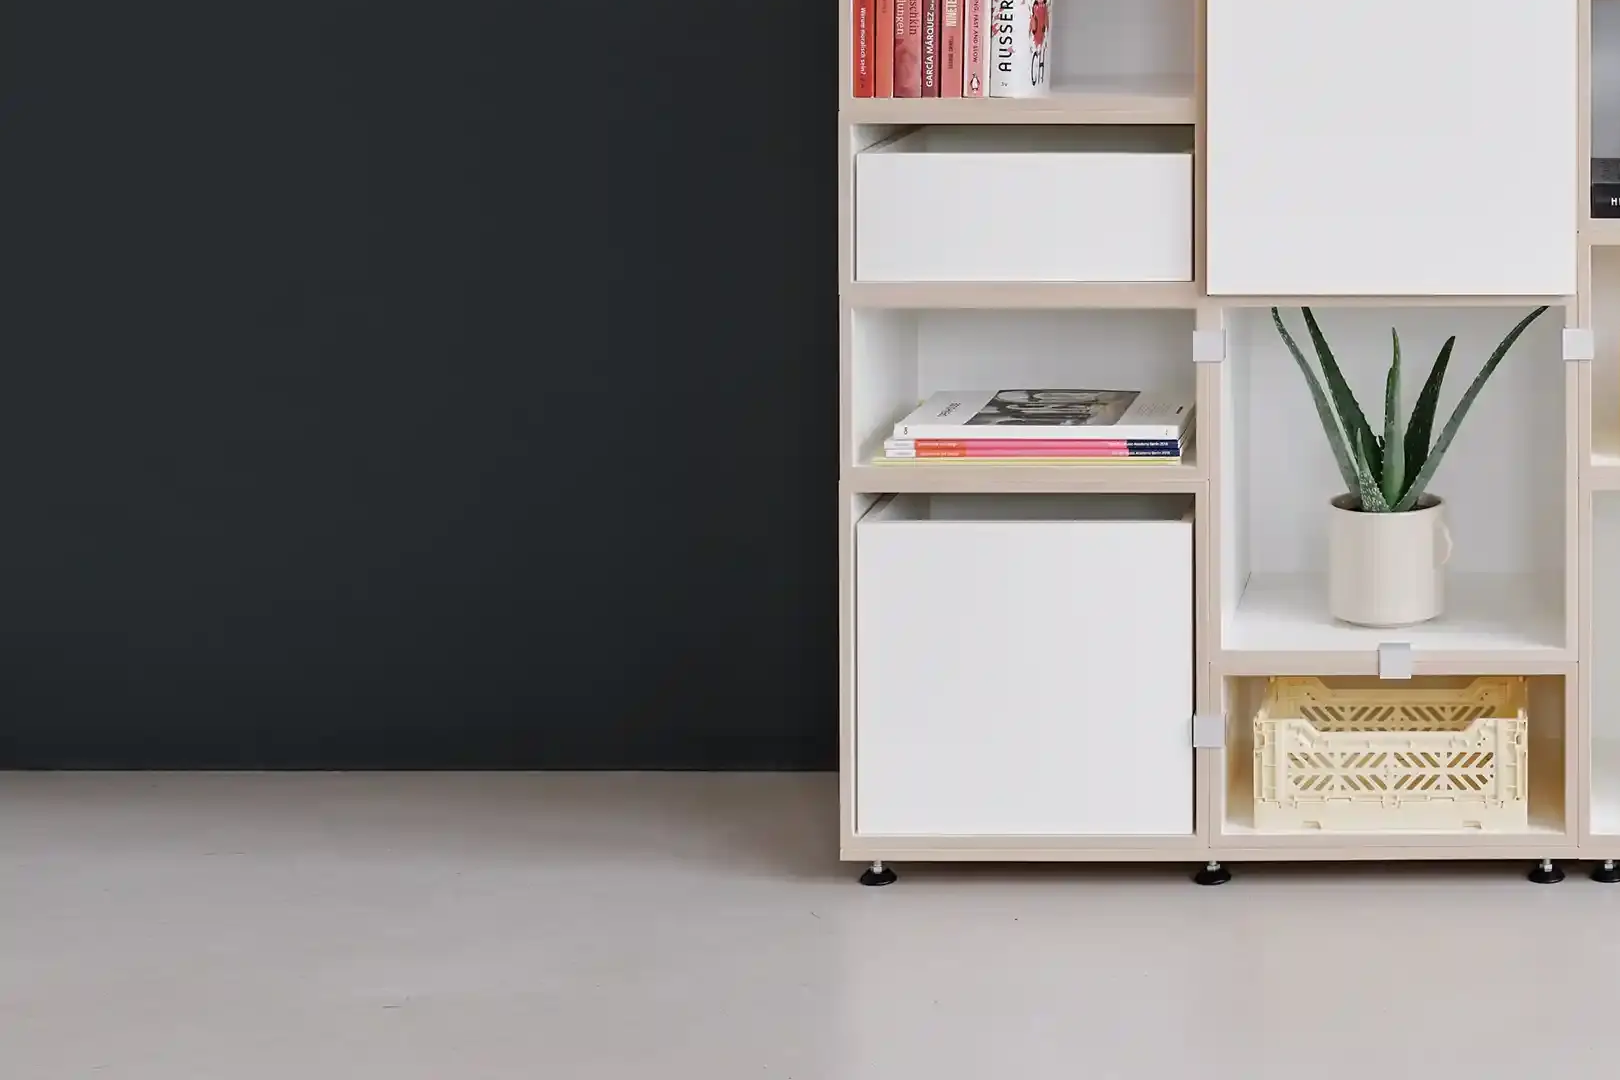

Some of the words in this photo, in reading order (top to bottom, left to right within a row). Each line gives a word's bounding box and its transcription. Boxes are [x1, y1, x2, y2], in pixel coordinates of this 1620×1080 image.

[925, 12, 934, 54] MÁRQUEZ
[998, 0, 1015, 72] AUSSER
[925, 55, 934, 87] GARCÍA
